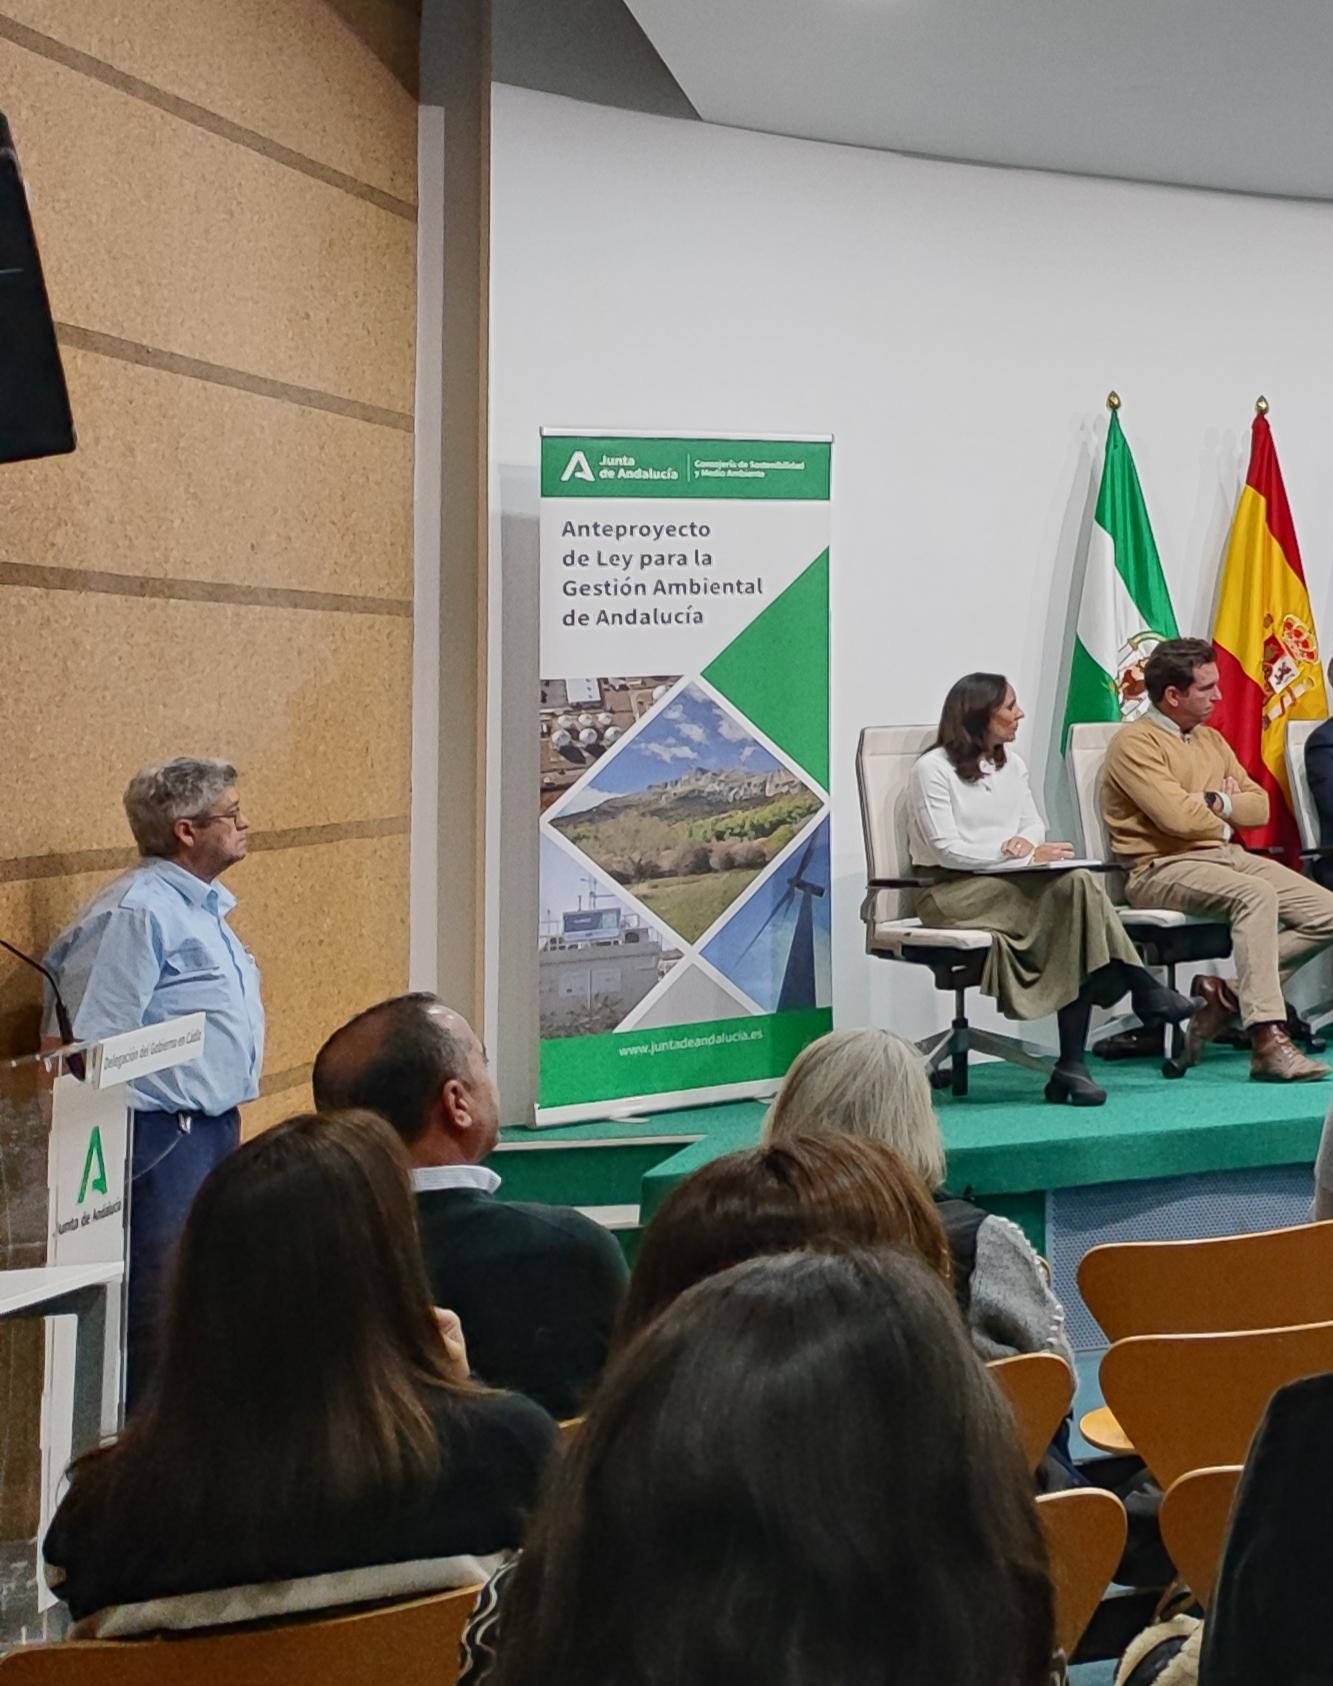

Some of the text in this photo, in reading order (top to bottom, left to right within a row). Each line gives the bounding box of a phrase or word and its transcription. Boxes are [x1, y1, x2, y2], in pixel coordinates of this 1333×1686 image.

[599, 455, 635, 467] Junta
[599, 467, 679, 480] de Andalucía
[561, 520, 711, 541] Anteproyecto
[562, 549, 712, 571] de Ley para la
[562, 576, 763, 597] Gestión Ambiental
[562, 605, 704, 626] de Andalucía
[618, 1029, 764, 1057] www.juntadeandalucia.es
